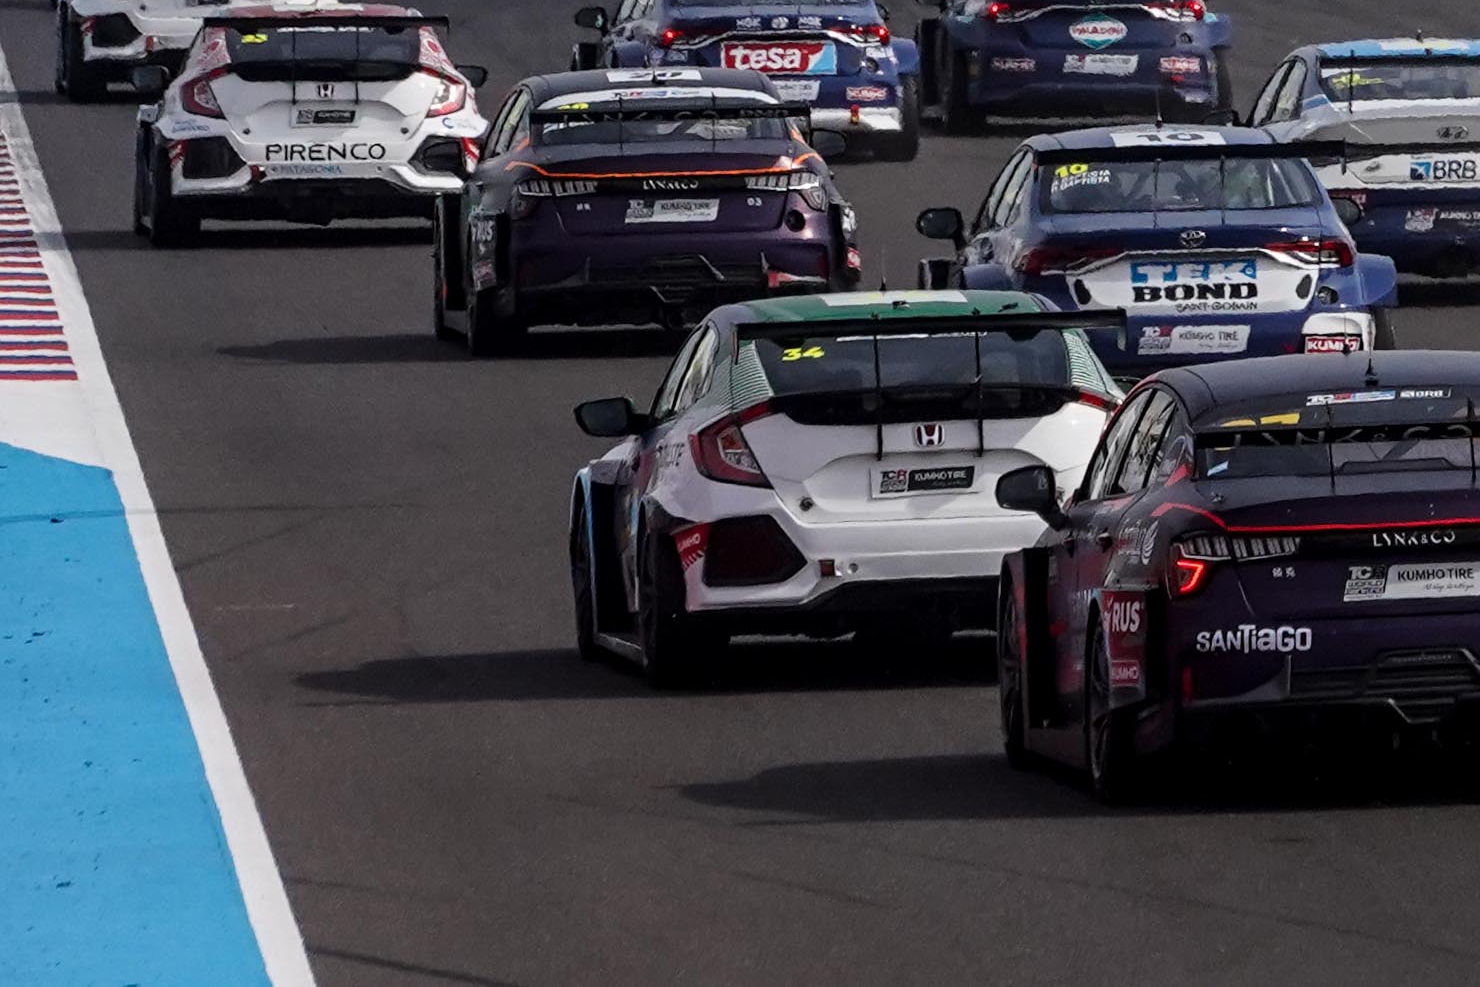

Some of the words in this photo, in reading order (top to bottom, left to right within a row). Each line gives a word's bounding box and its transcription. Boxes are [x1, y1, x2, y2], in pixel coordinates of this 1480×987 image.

[728, 47, 803, 72] tesa
[265, 143, 386, 161] PIRENCO
[1055, 164, 1089, 179] 10
[1433, 159, 1477, 180] BRB
[1132, 283, 1258, 302] BOND
[782, 346, 825, 362] 34
[1397, 567, 1446, 583] KUMHO
[1447, 567, 1475, 580] TIRE
